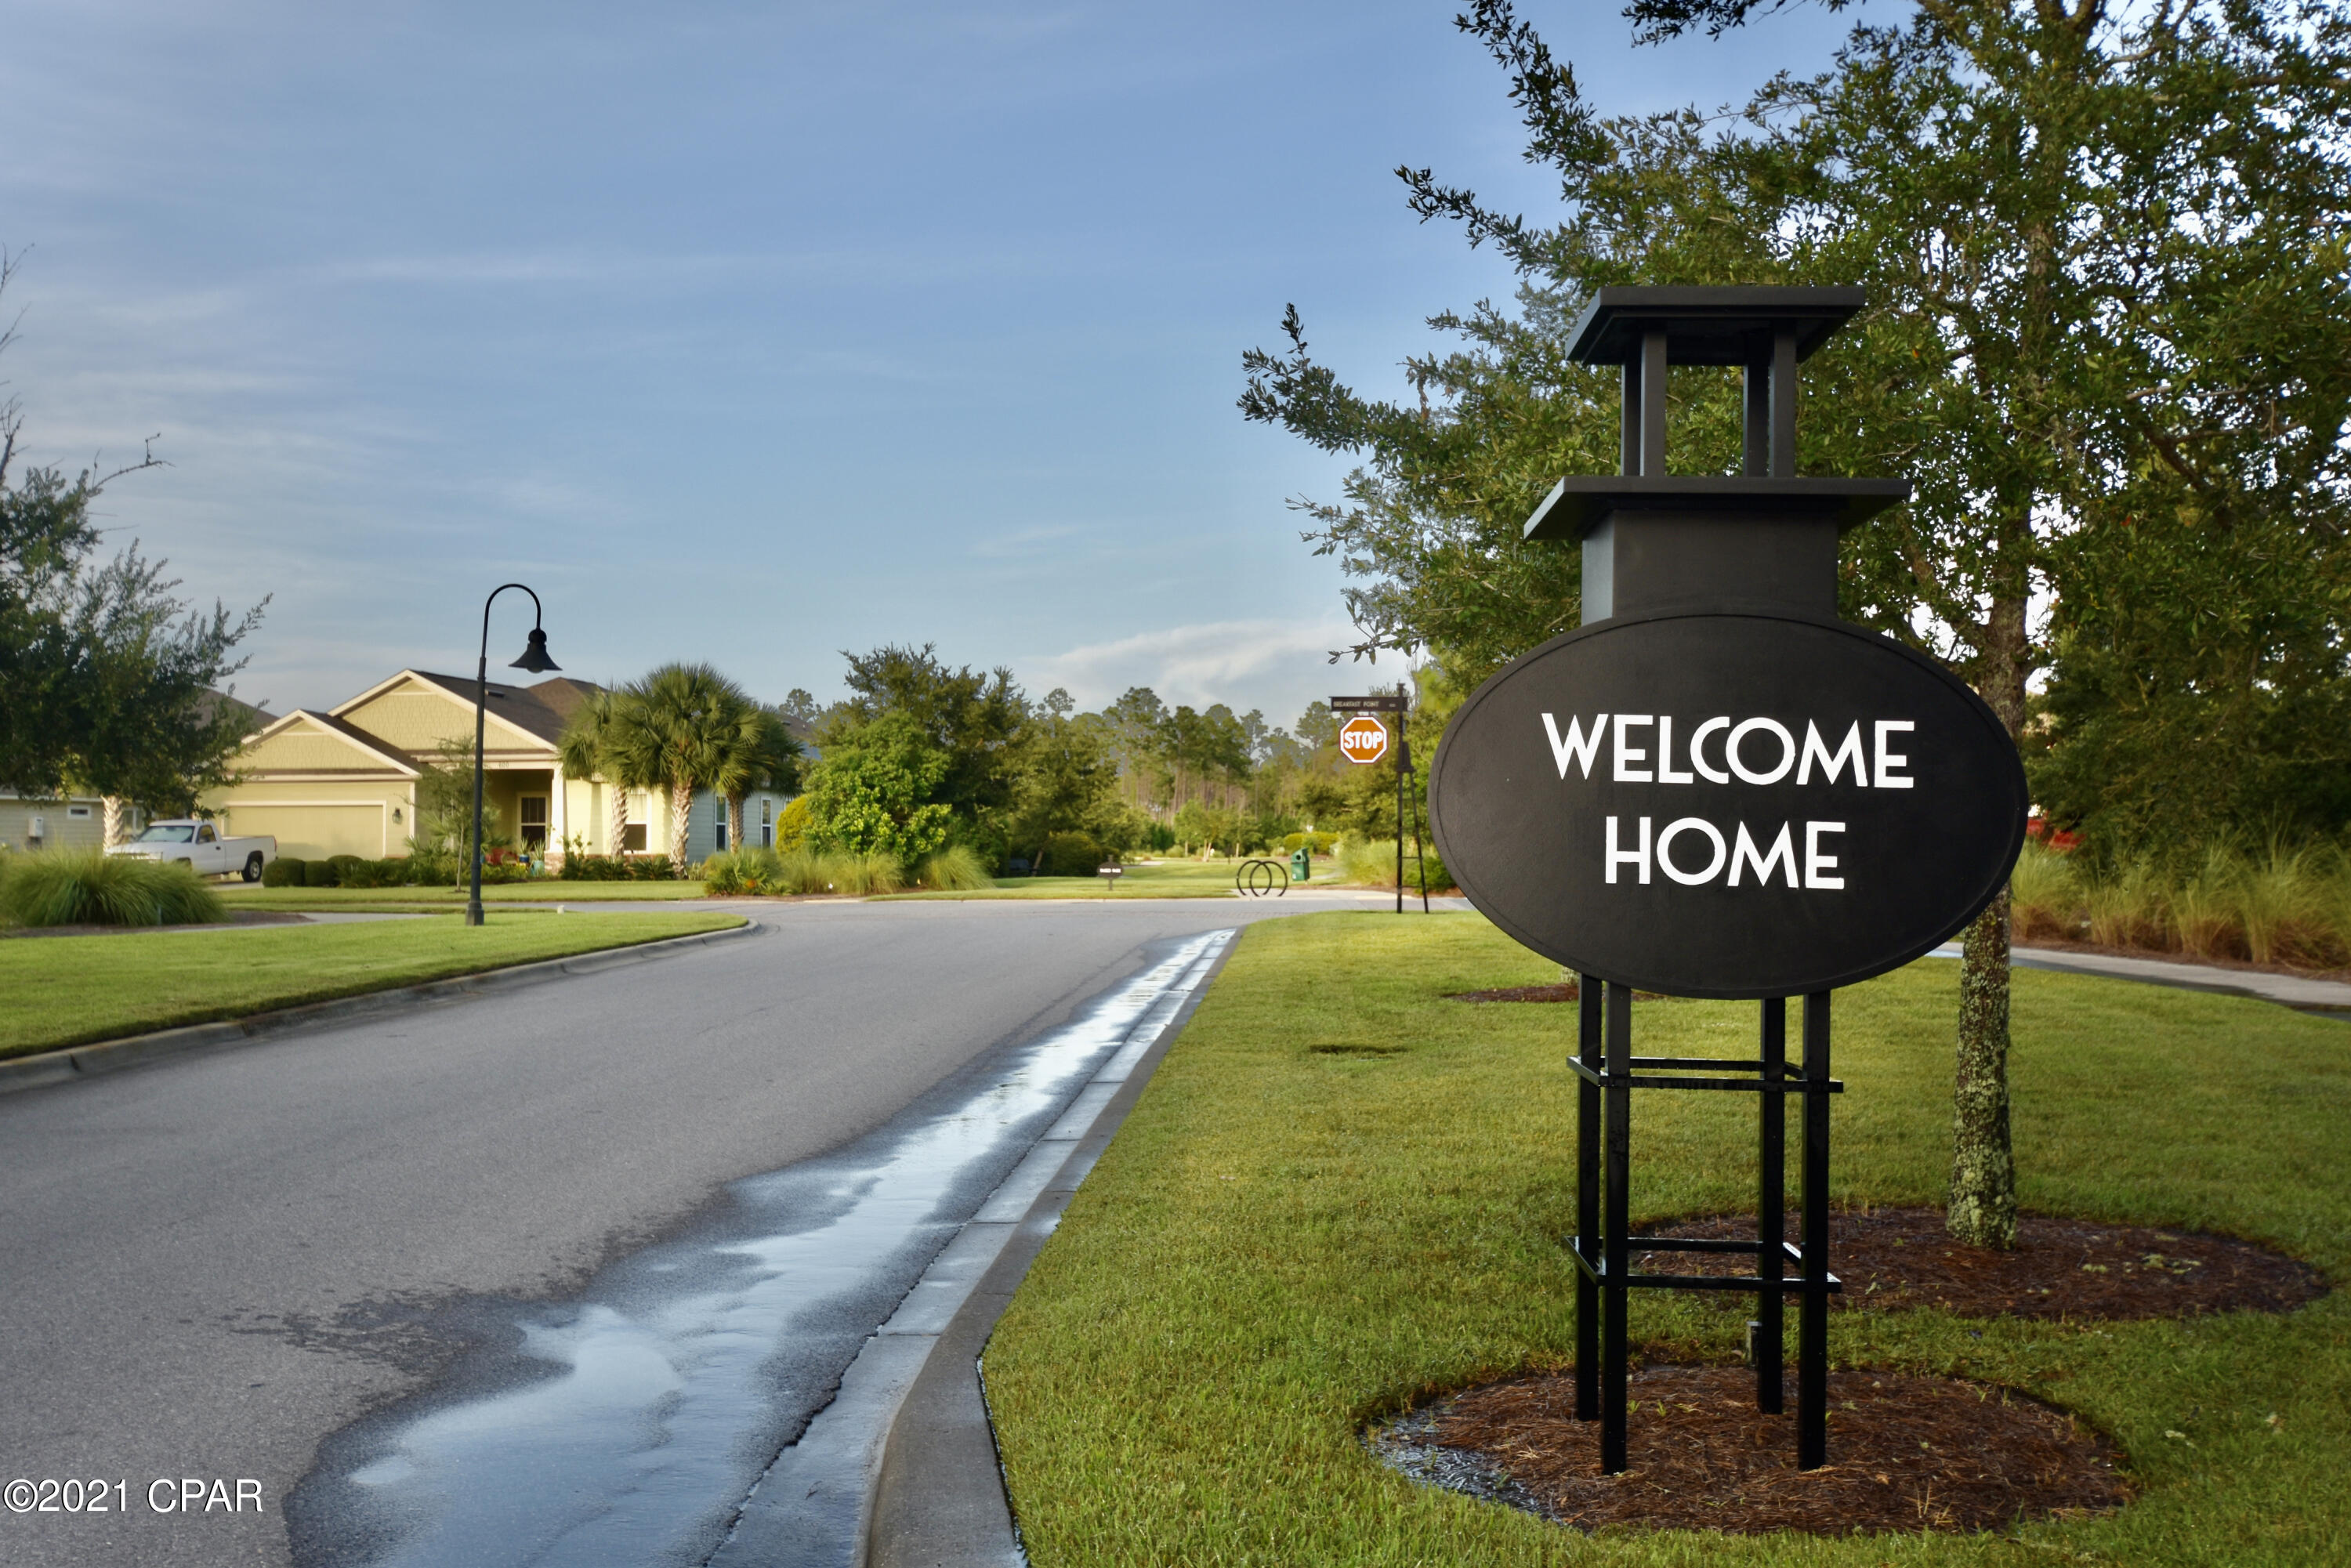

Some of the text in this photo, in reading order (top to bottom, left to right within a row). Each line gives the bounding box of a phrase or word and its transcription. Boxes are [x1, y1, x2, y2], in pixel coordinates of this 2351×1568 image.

[1344, 731, 1383, 749] STOP
[1541, 713, 1914, 788] WELCOME
[1606, 817, 1846, 889] HOME
